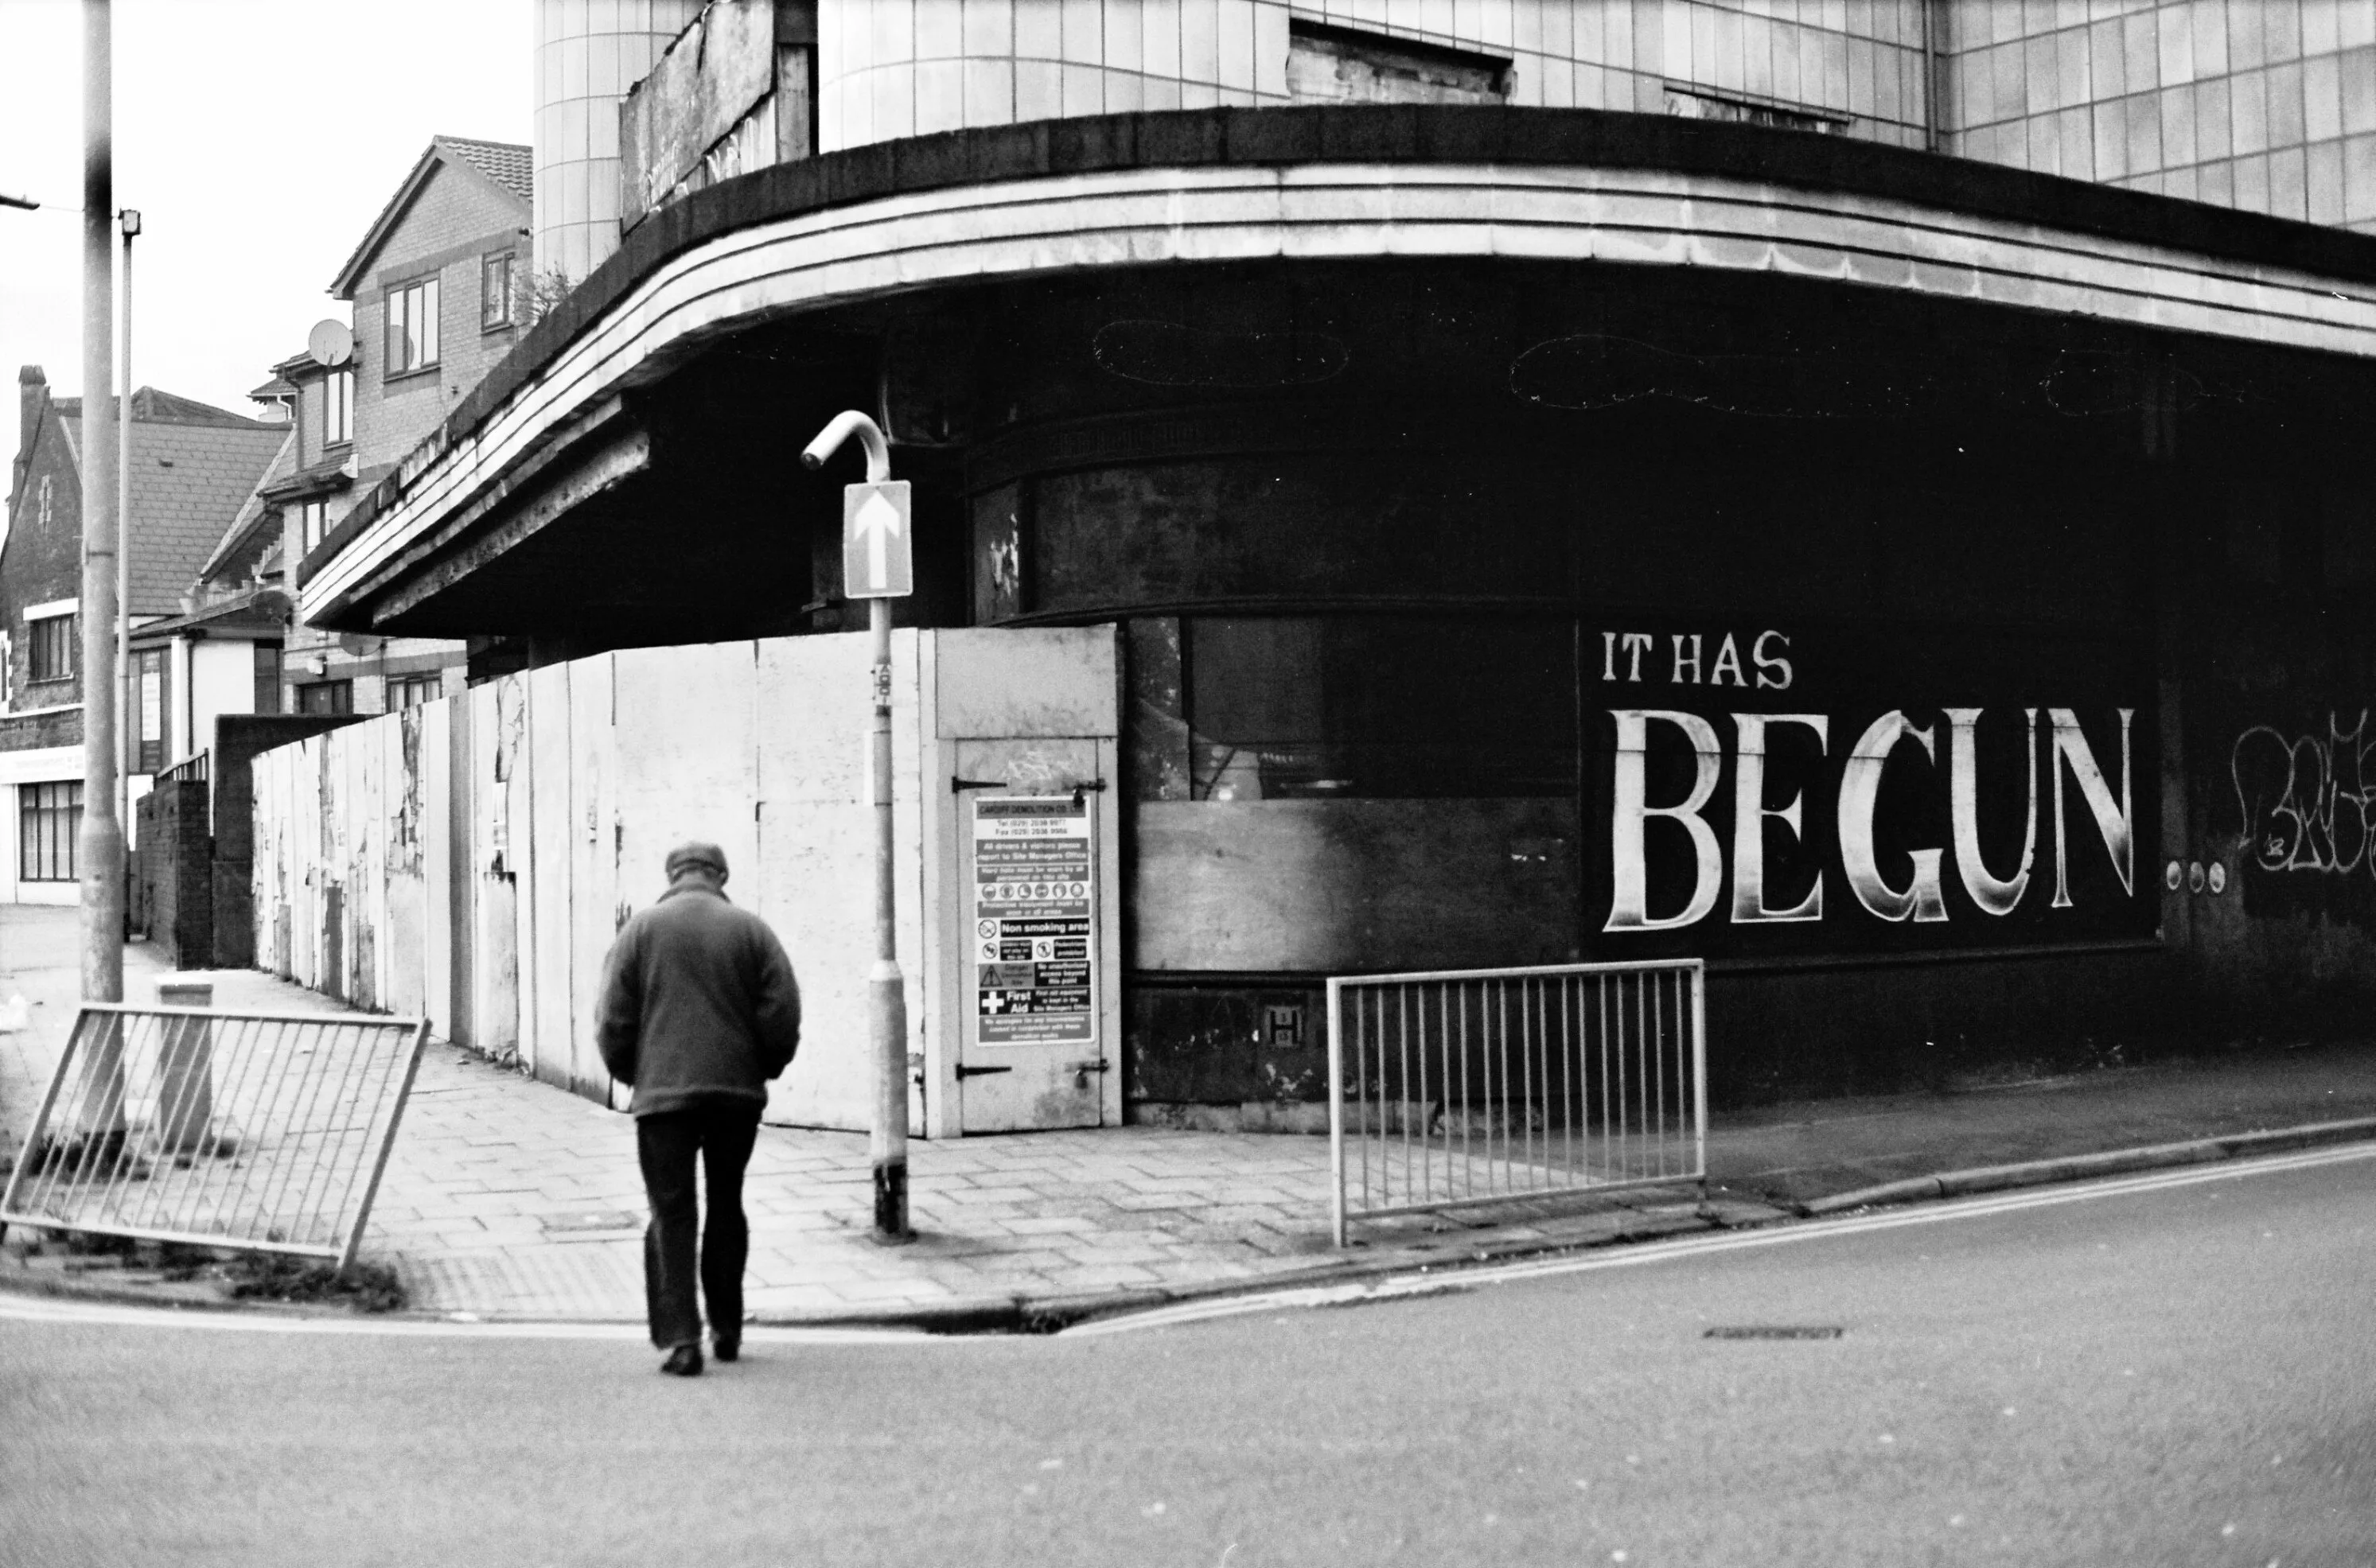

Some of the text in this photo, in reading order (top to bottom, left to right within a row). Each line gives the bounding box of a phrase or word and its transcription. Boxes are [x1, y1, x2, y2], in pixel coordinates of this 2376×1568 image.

[1602, 630, 1793, 690] IT HAS
[1602, 707, 2135, 932] BEGUN
[1024, 923, 1065, 933] smoking
[1007, 991, 1031, 1001] First
[1011, 1003, 1029, 1013] Aid
[1269, 1010, 1298, 1044] H
